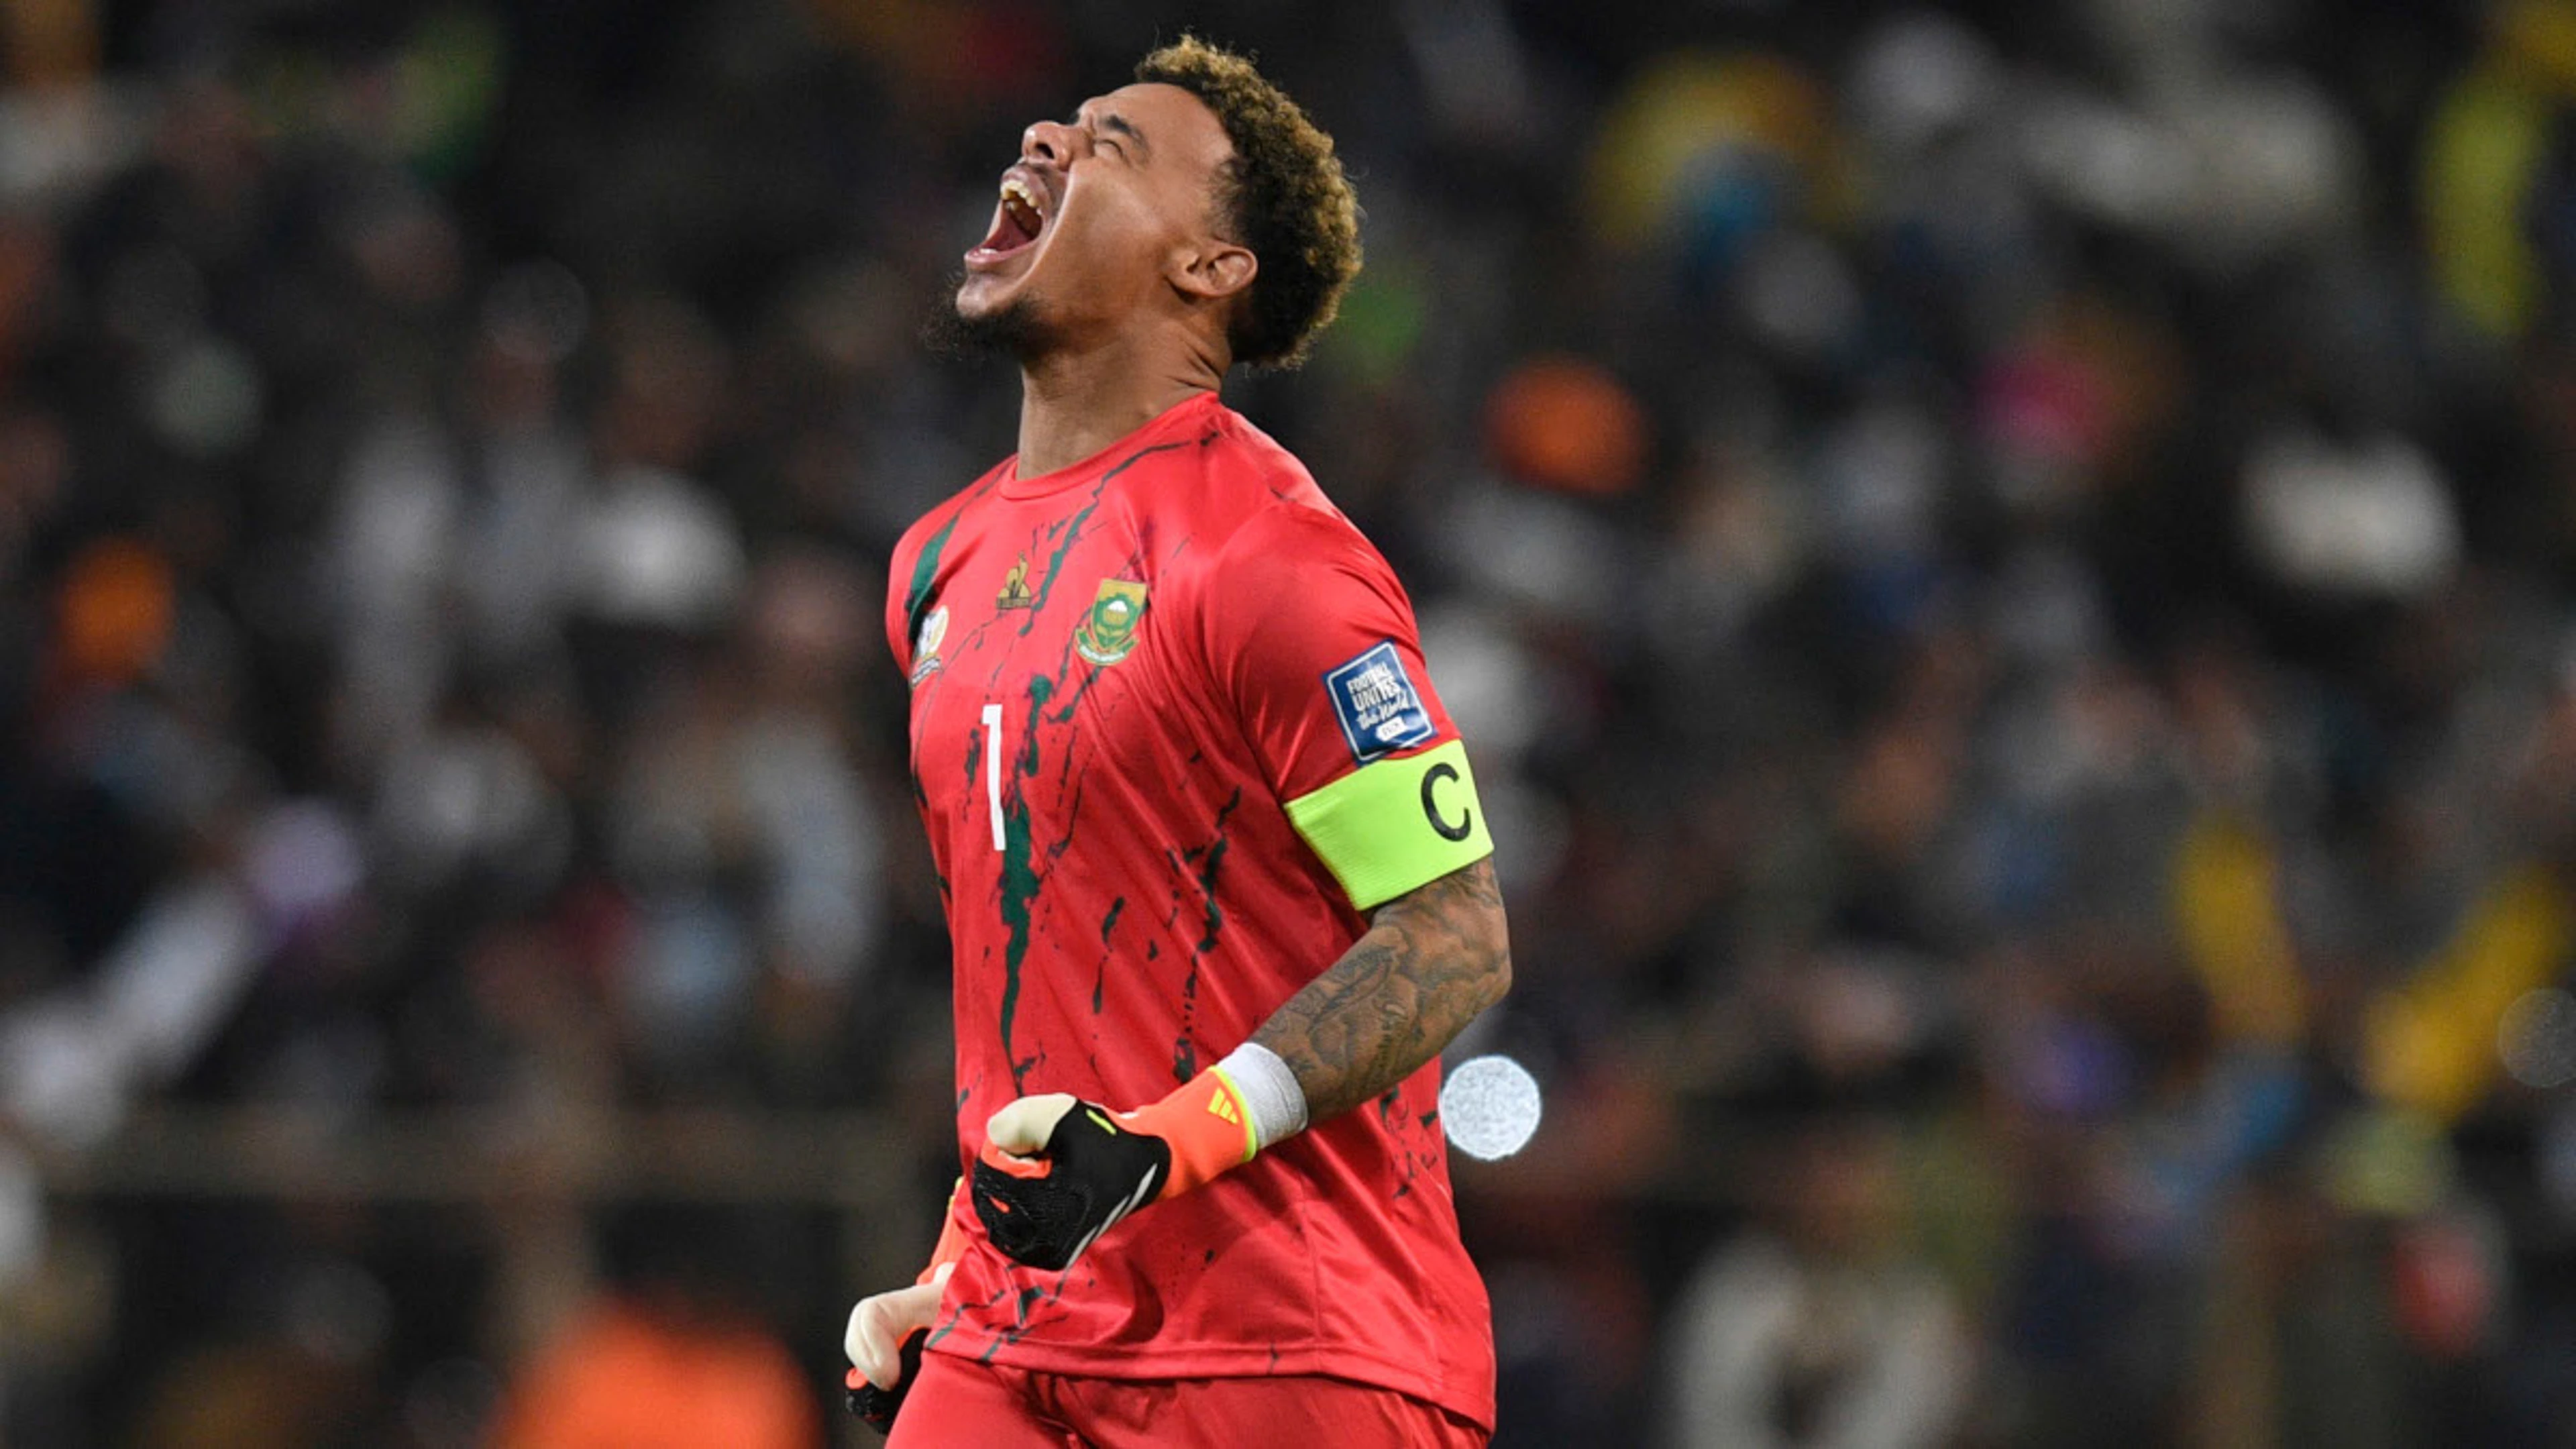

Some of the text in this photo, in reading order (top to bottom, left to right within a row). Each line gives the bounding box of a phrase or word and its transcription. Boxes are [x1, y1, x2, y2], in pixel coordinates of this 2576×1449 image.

[1346, 661, 1395, 692] FOOTL
[1352, 680, 1401, 711] UNITES
[982, 704, 1006, 851] 1
[1421, 762, 1471, 842] C
